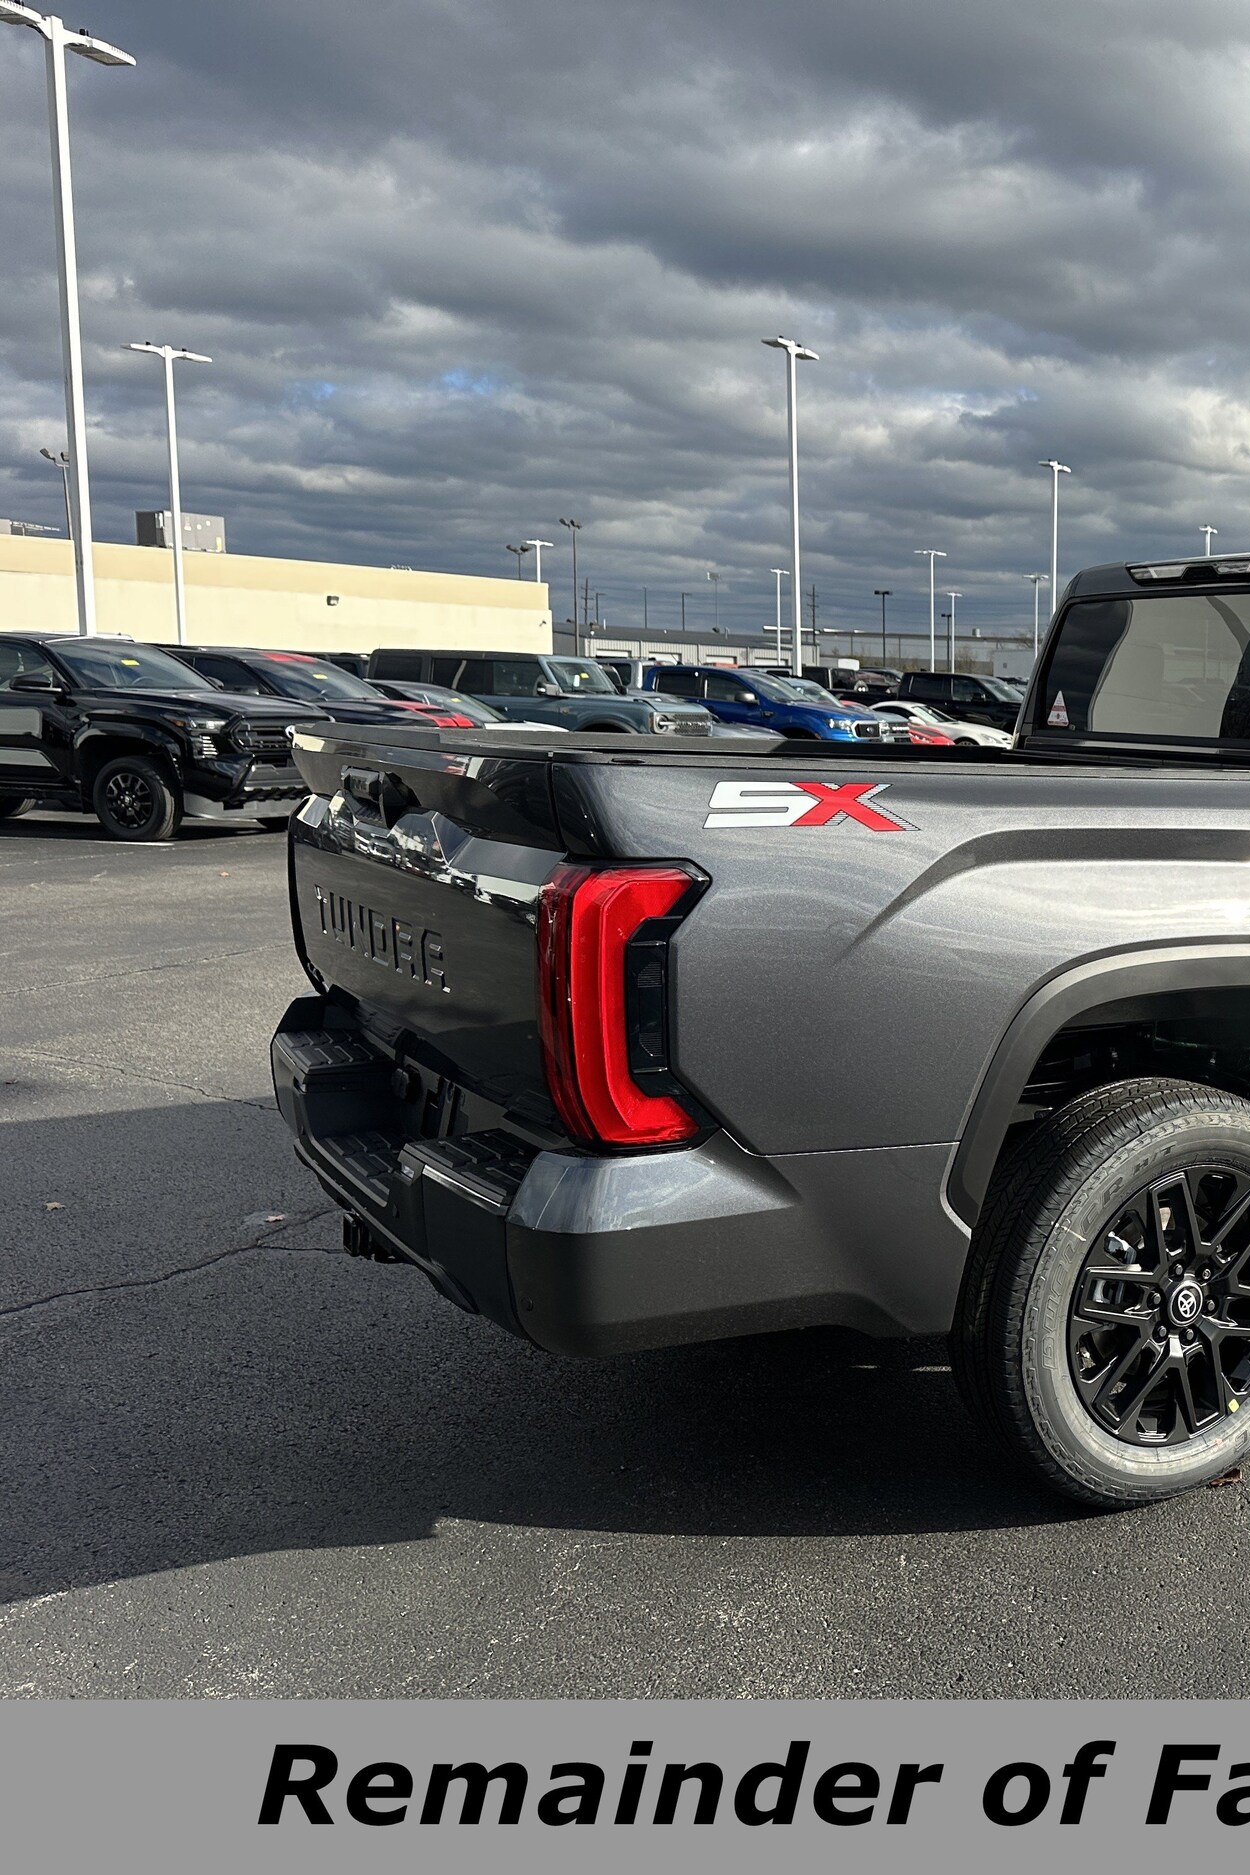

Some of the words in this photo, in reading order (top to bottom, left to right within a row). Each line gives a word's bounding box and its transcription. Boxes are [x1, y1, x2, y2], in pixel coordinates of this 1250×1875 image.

[702, 781, 922, 832] SX
[314, 883, 451, 993] TUNDRA
[1134, 1142, 1177, 1176] H/T
